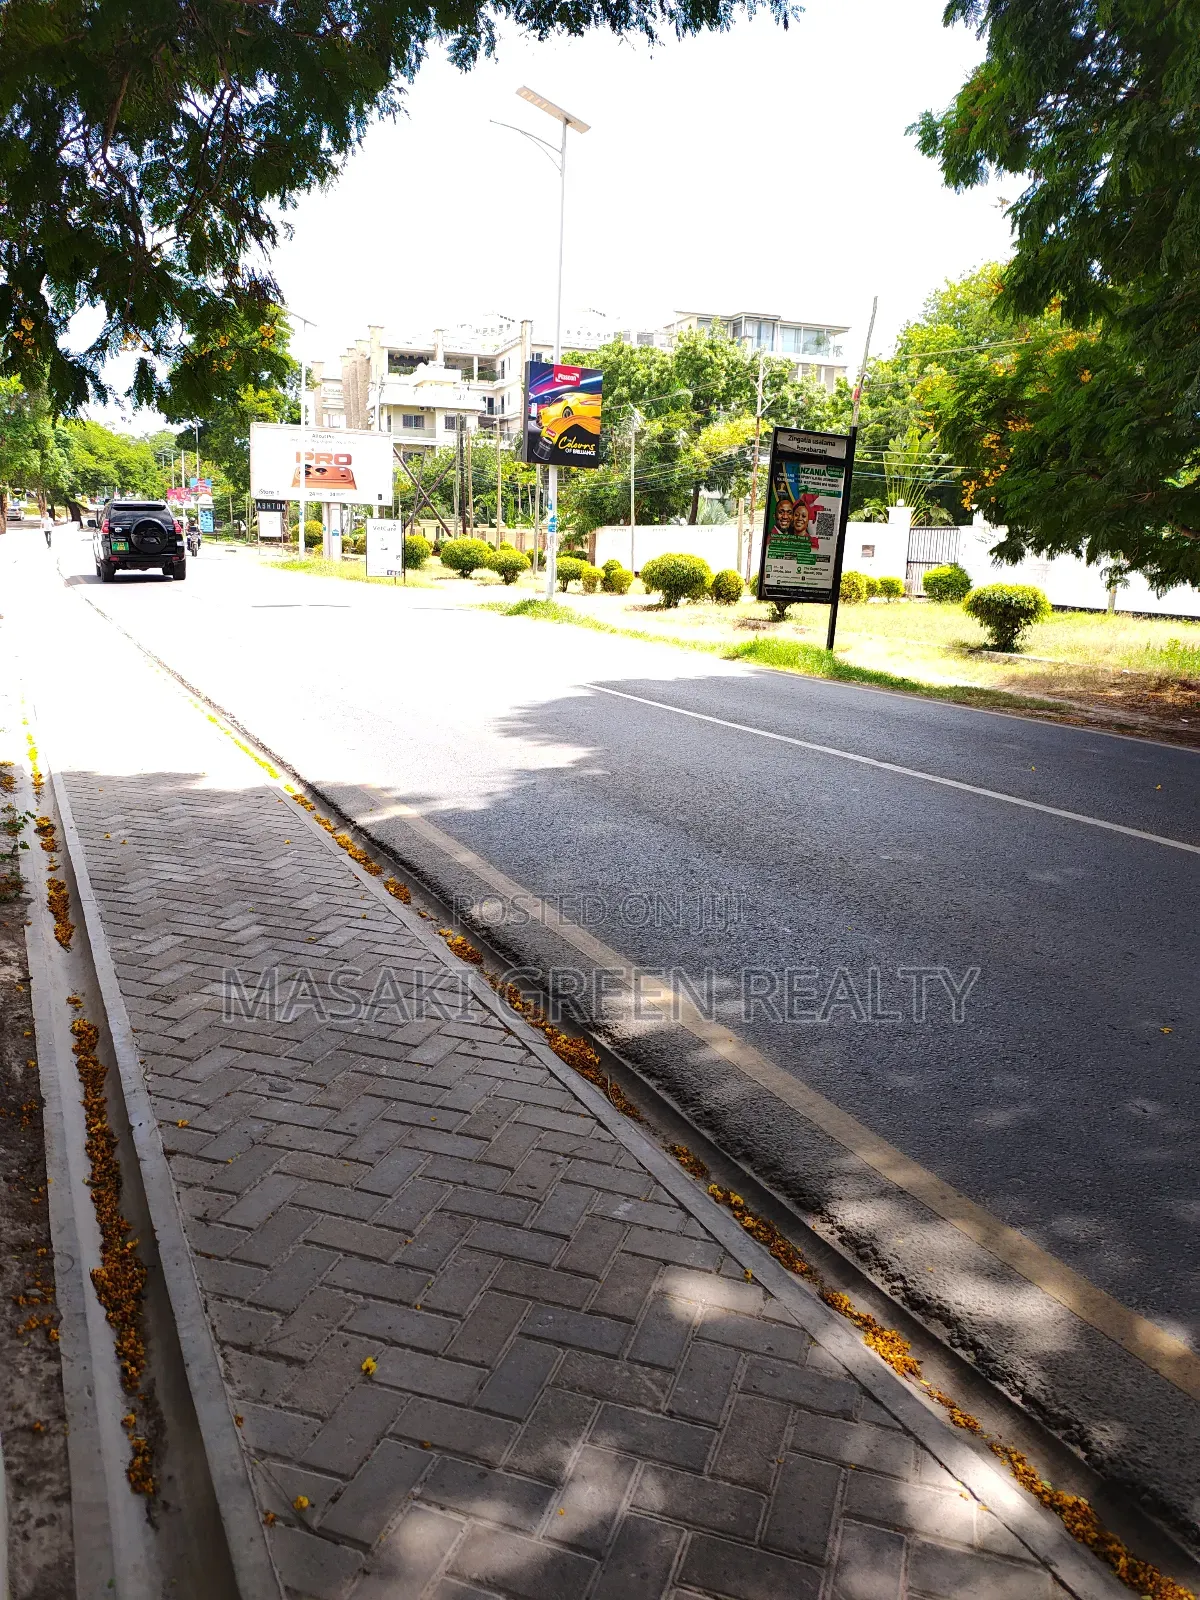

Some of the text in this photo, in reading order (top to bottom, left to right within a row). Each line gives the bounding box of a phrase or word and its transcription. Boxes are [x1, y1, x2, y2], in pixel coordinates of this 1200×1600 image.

[558, 436, 596, 451] Colours
[788, 434, 836, 447] Zingatia usalama
[295, 451, 353, 466] PRO
[572, 448, 597, 456] BRILLIANCE
[256, 502, 286, 511] ASHTON
